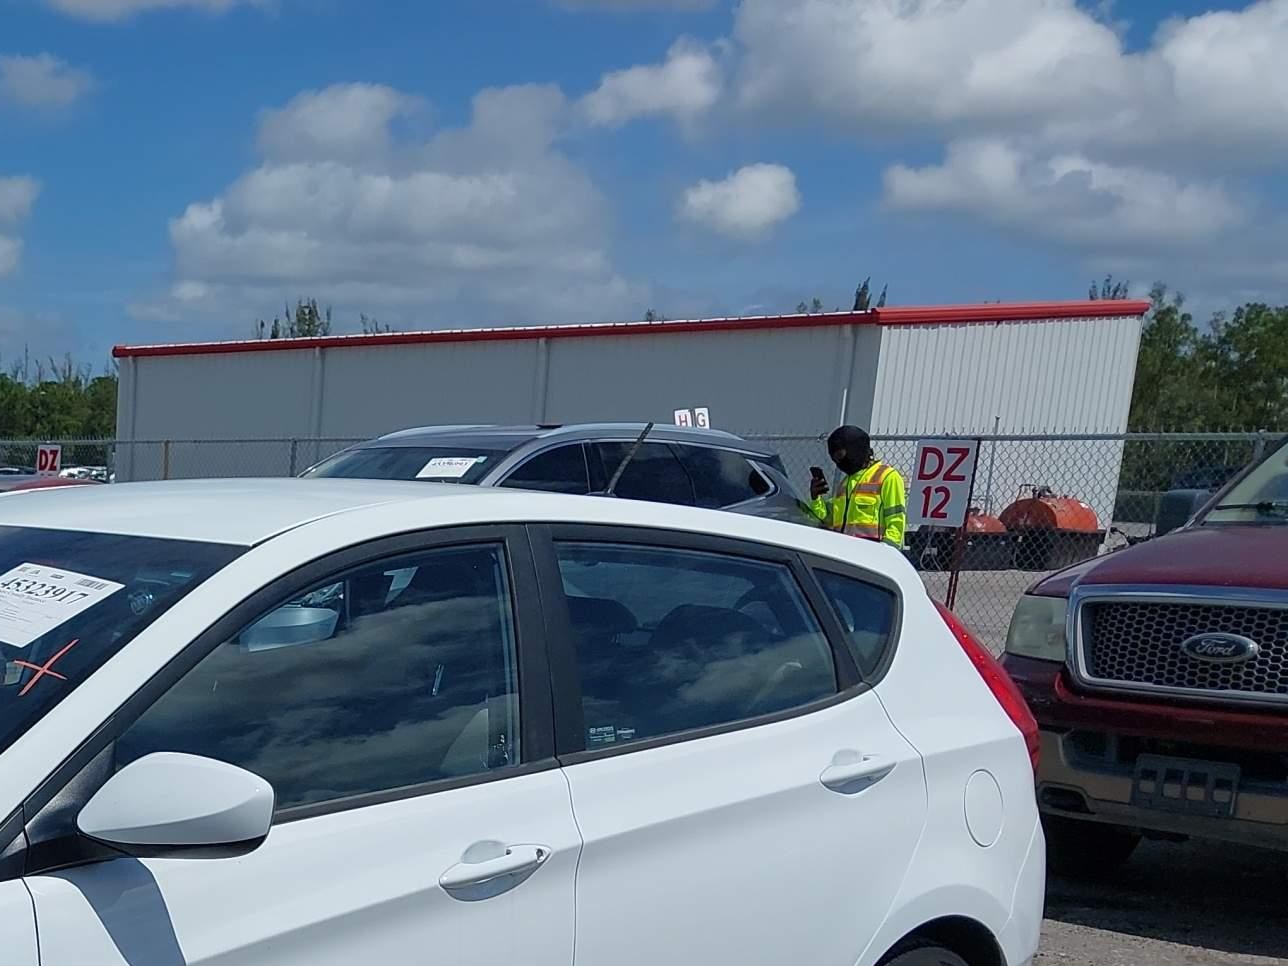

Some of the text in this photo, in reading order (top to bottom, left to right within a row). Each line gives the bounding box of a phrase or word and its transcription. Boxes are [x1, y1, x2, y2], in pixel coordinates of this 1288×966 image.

[678, 413, 688, 427] H
[696, 412, 707, 428] G
[38, 449, 60, 471] DZ
[917, 446, 971, 481] DZ
[922, 486, 951, 518] 12
[0, 577, 89, 604] 45323917
[1195, 638, 1236, 656] Ford
